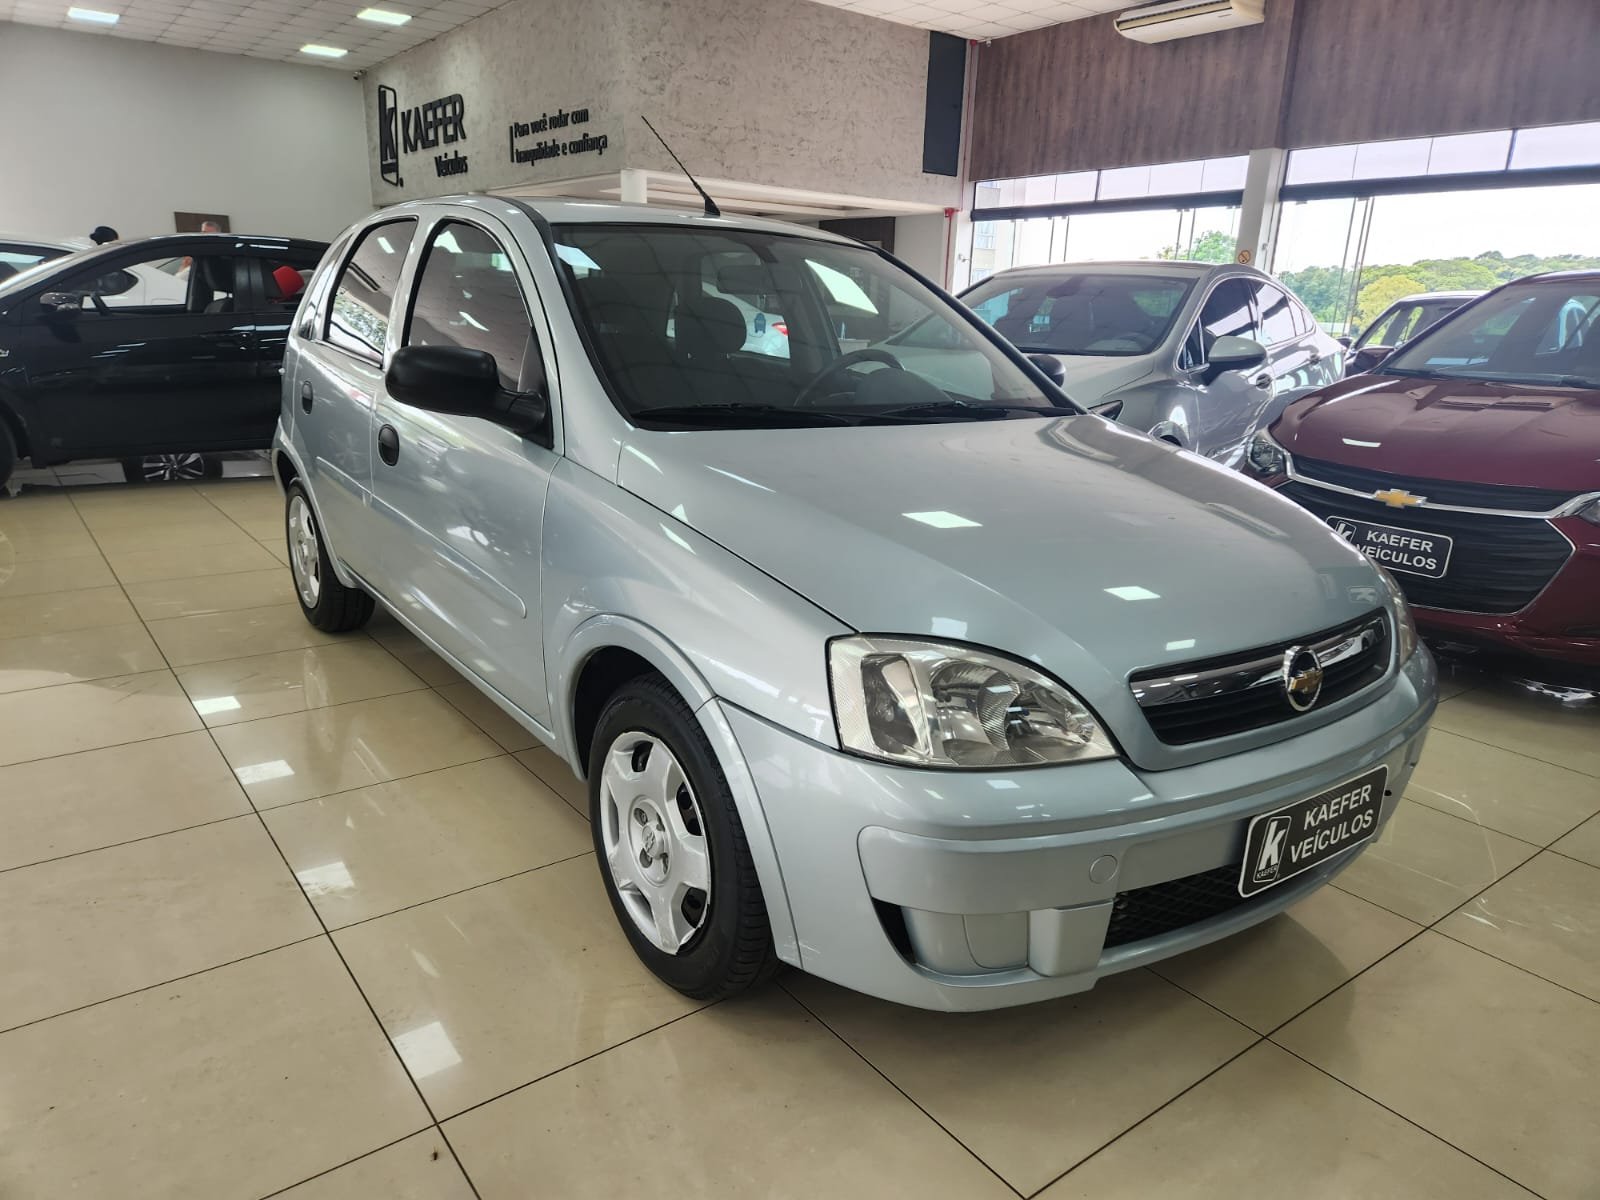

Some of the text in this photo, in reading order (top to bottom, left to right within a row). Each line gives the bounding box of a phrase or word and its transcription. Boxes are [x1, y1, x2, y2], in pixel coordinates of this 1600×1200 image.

[401, 93, 466, 154] KAEFER
[514, 108, 589, 138] Para você rodar com
[434, 150, 468, 177] Veículos
[515, 133, 608, 166] tranquilidade e confiança
[1366, 530, 1433, 552] KAEFER
[1356, 543, 1438, 571] VEÍCULOS
[1303, 784, 1371, 830] KAEFER
[1290, 809, 1374, 863] VEÍCULOS
[1256, 865, 1278, 879] KAEFER
